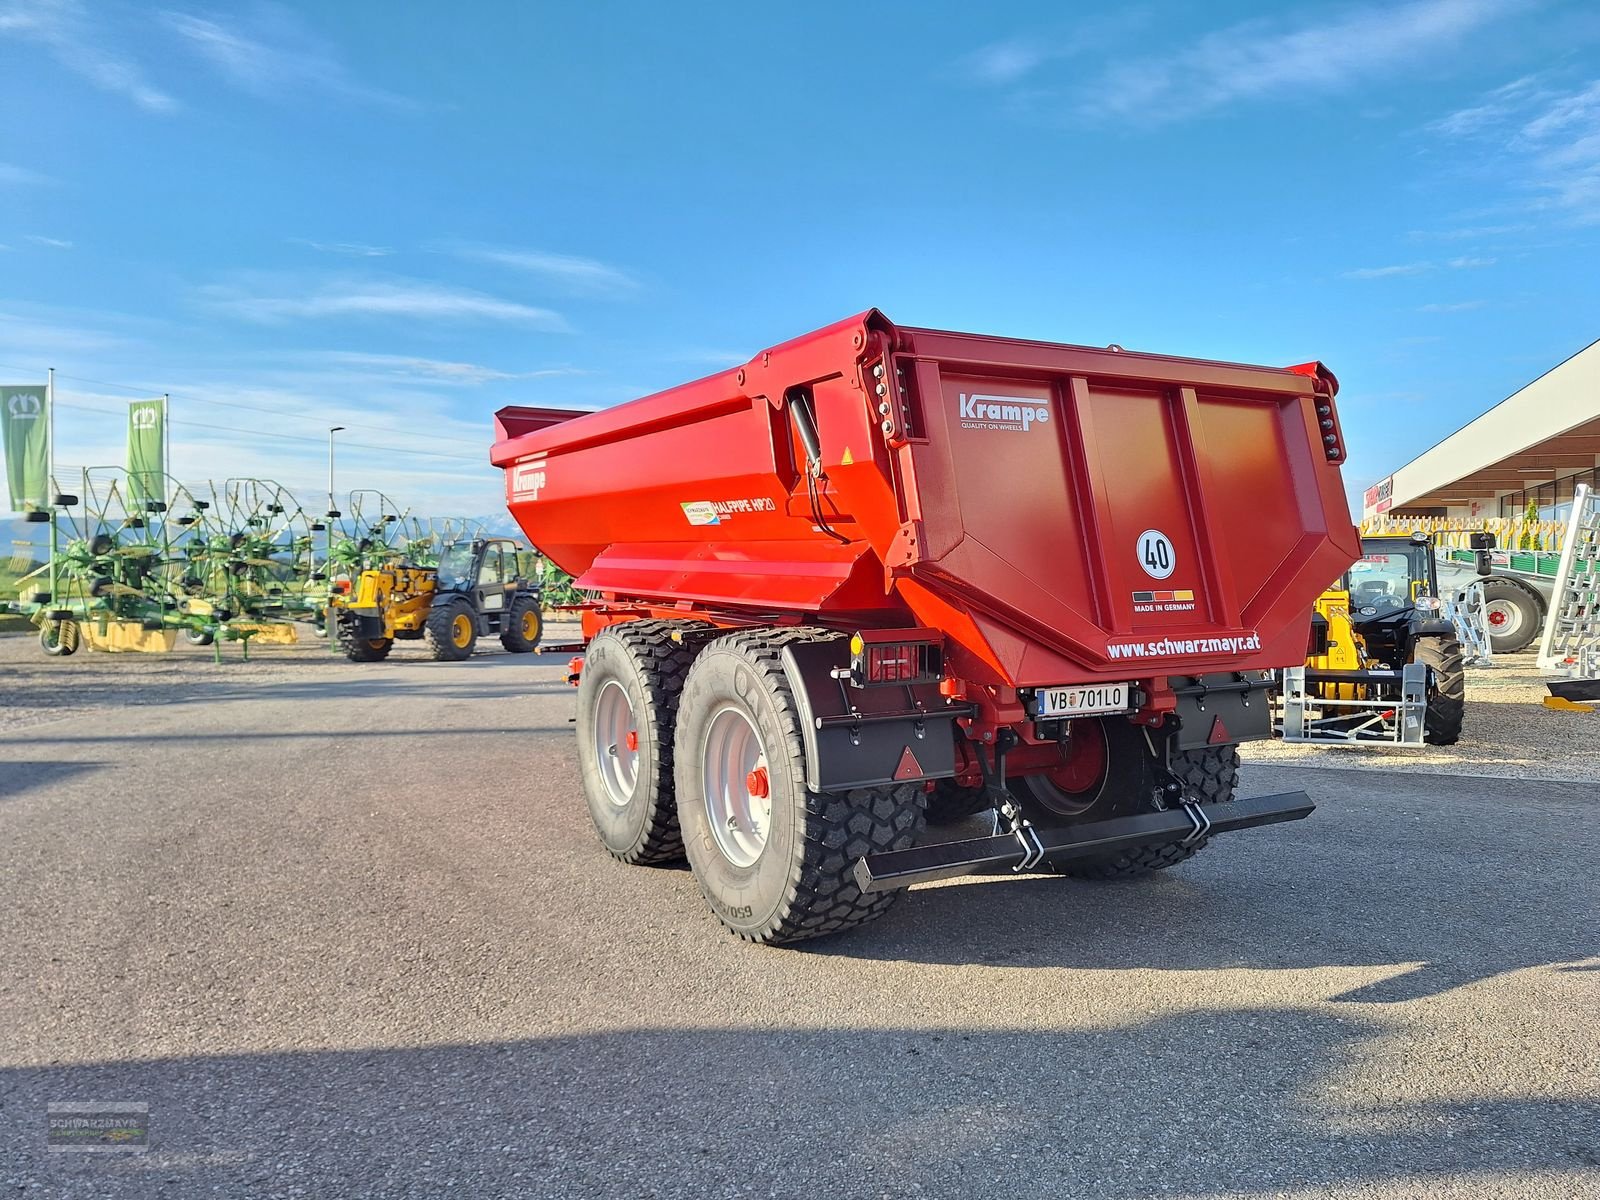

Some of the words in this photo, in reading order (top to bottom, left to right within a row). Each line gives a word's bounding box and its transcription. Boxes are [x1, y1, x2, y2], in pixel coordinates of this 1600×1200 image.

[960, 393, 1048, 431] Krampe
[711, 499, 753, 514] HALFPIPE
[751, 497, 776, 512] HP20
[1145, 539, 1169, 570] 40
[1155, 604, 1163, 612] IN
[1164, 603, 1195, 611] GERMANY
[1107, 632, 1261, 658] www.schwarzmayr.at
[1050, 692, 1067, 710] VB
